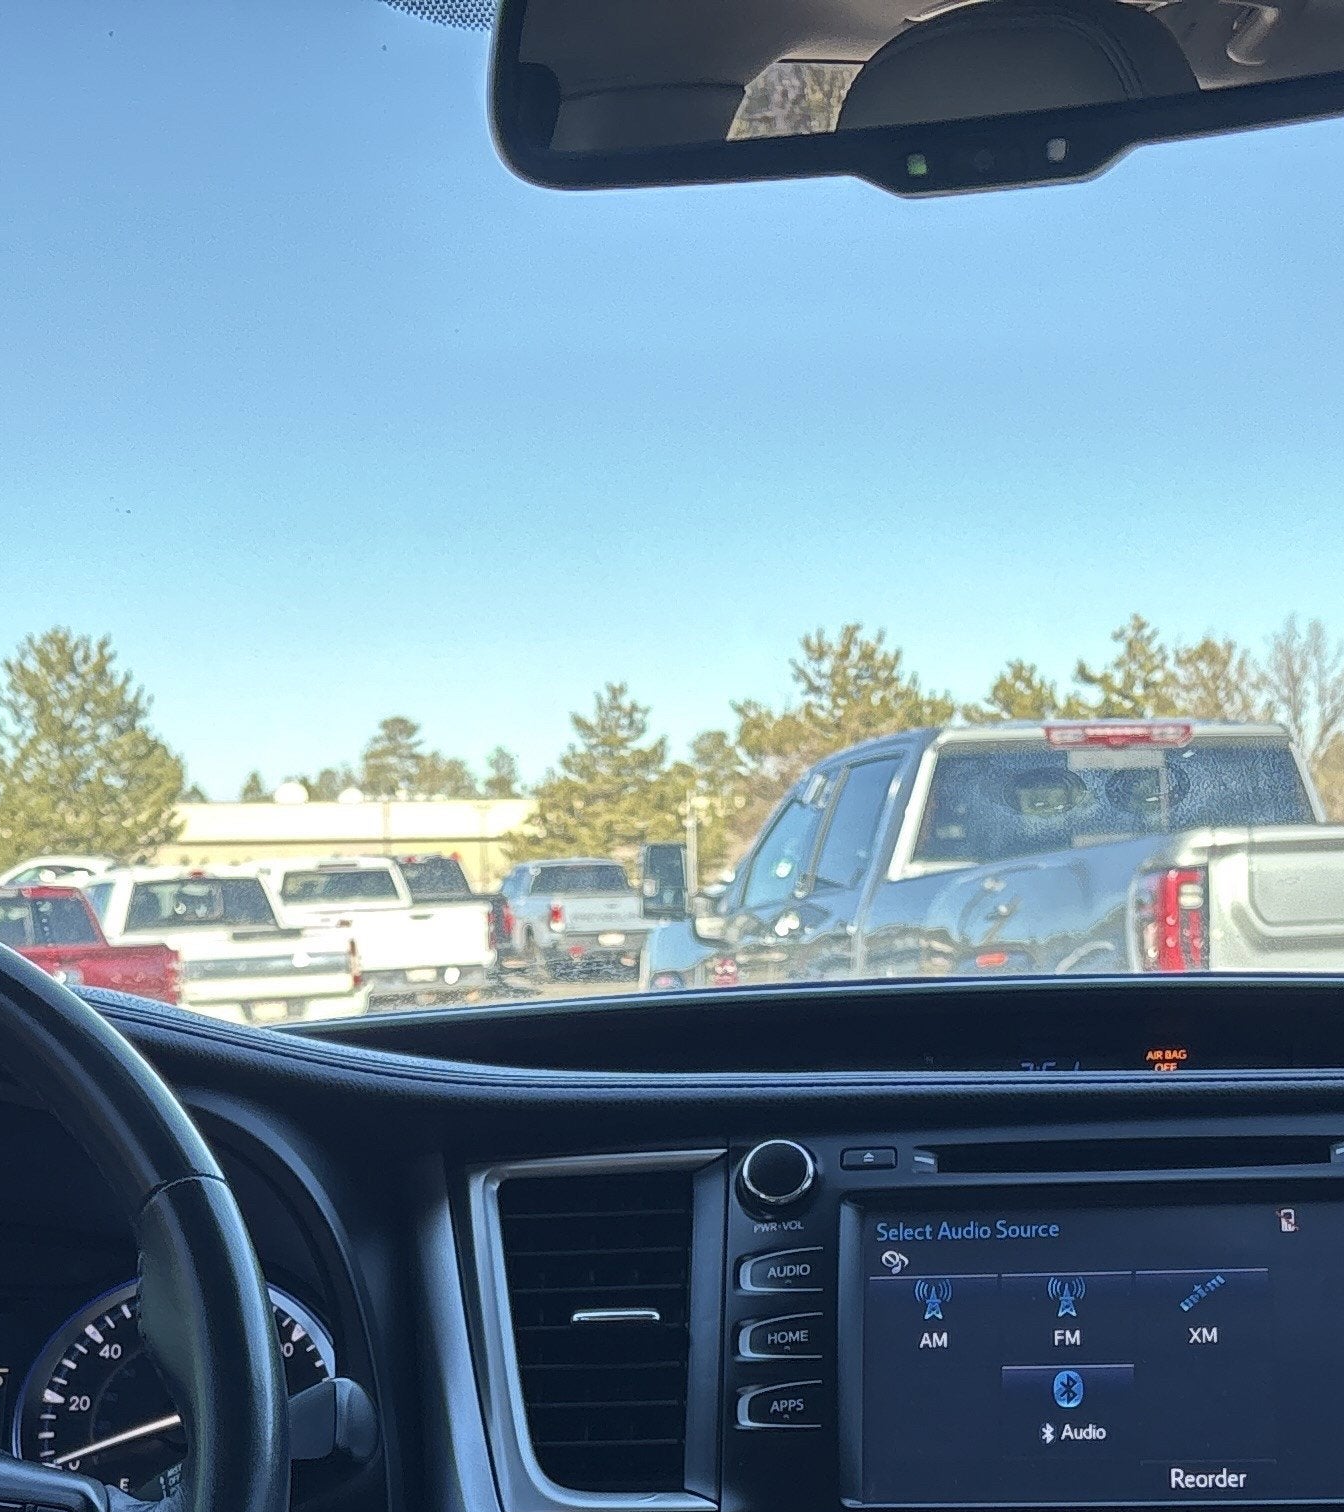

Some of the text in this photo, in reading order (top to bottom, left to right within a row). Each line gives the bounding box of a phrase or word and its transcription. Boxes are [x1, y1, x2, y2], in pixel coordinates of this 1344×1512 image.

[1145, 1050, 1163, 1061] AIR
[876, 1219, 1061, 1242] Select Audio Source
[767, 1264, 811, 1279] AUDIO
[767, 1330, 809, 1345] HOME
[919, 1331, 948, 1349] AM
[1054, 1329, 1081, 1346] FM
[1188, 1327, 1218, 1344] XM
[99, 1343, 122, 1360] 40
[68, 1395, 91, 1411] 20
[770, 1399, 804, 1413] APPS
[1060, 1423, 1106, 1440] Audio
[120, 1477, 130, 1492] E
[1170, 1467, 1248, 1489] Reorder
